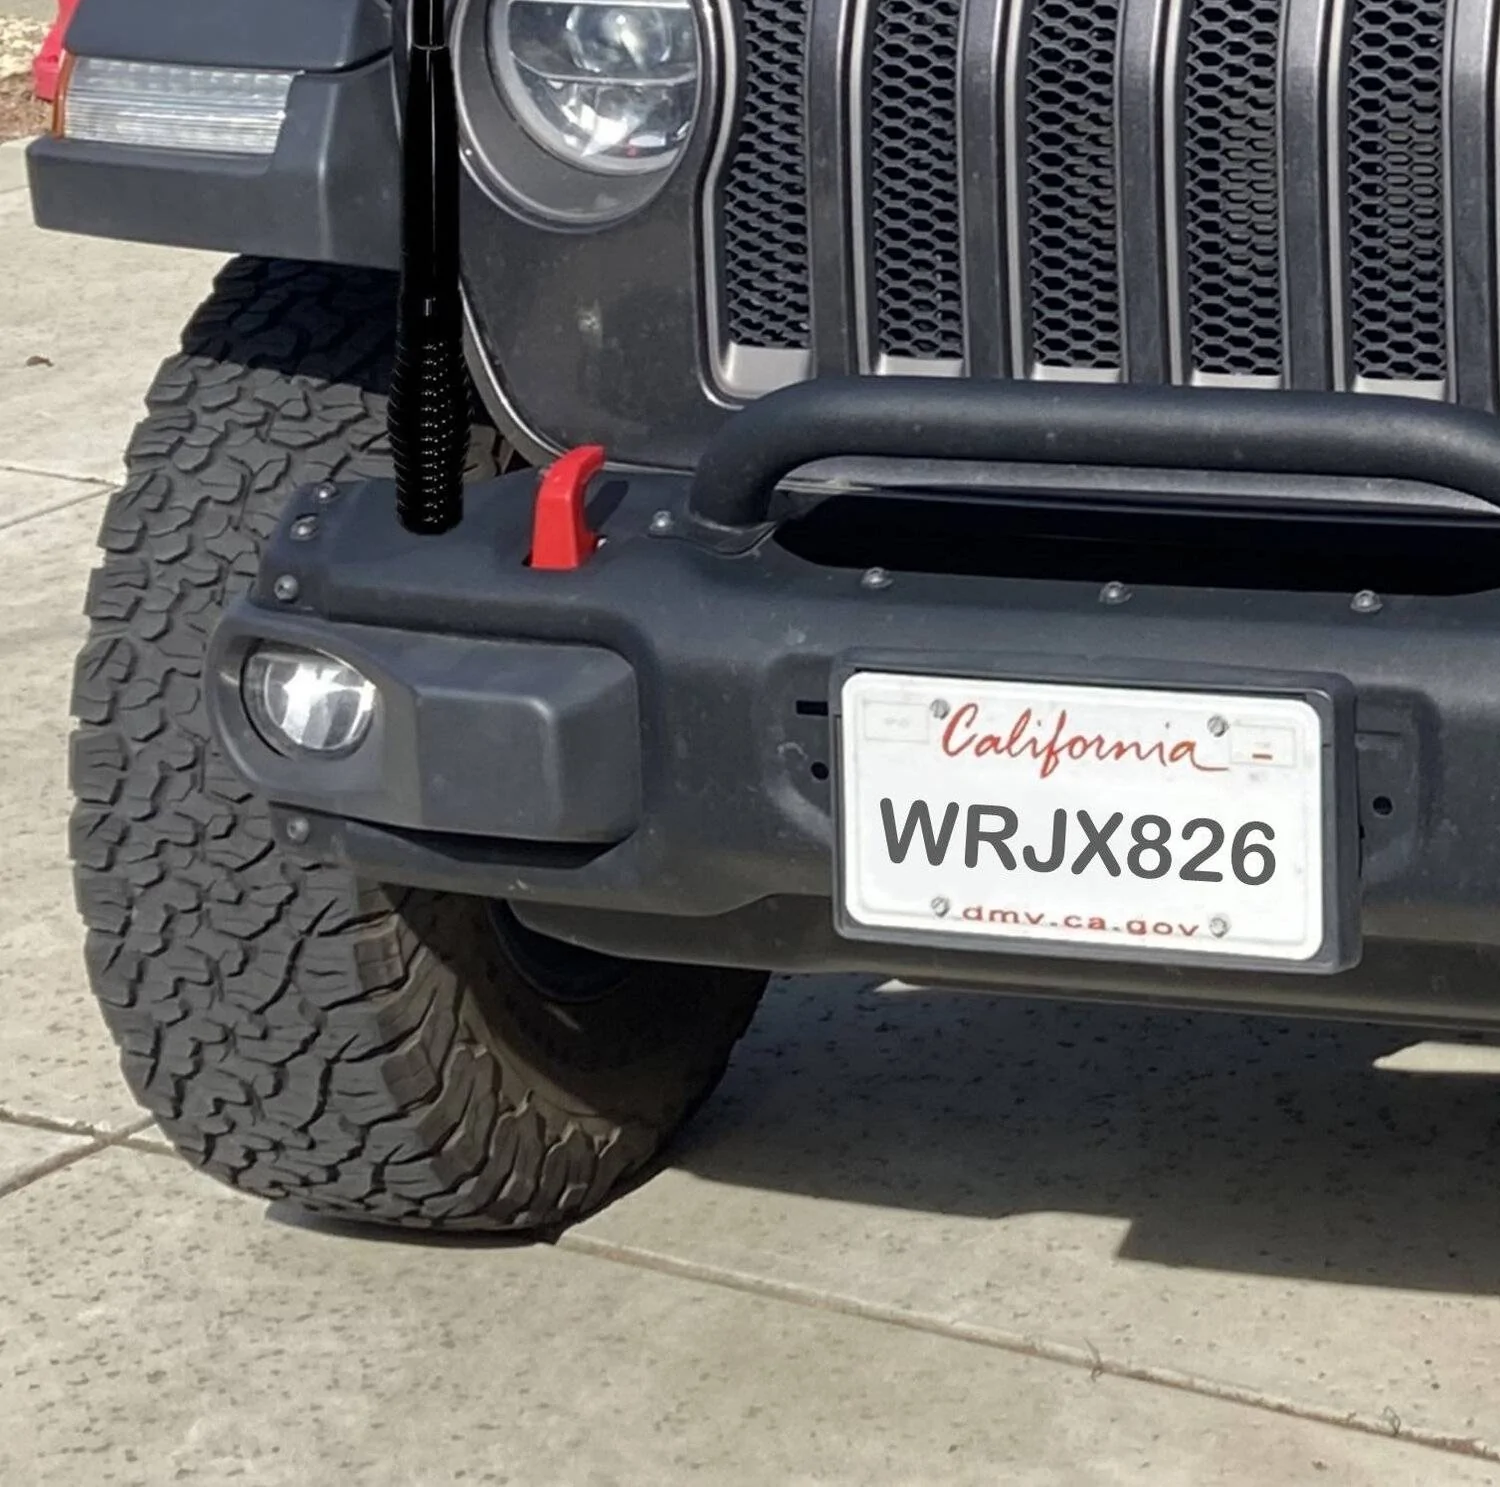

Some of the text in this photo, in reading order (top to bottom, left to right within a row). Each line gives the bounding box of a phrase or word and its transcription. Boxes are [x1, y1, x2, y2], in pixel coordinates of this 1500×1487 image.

[941, 702, 1229, 779] California
[880, 798, 1276, 886] WRJX826
[962, 904, 1200, 937] dmv.ca.gov
